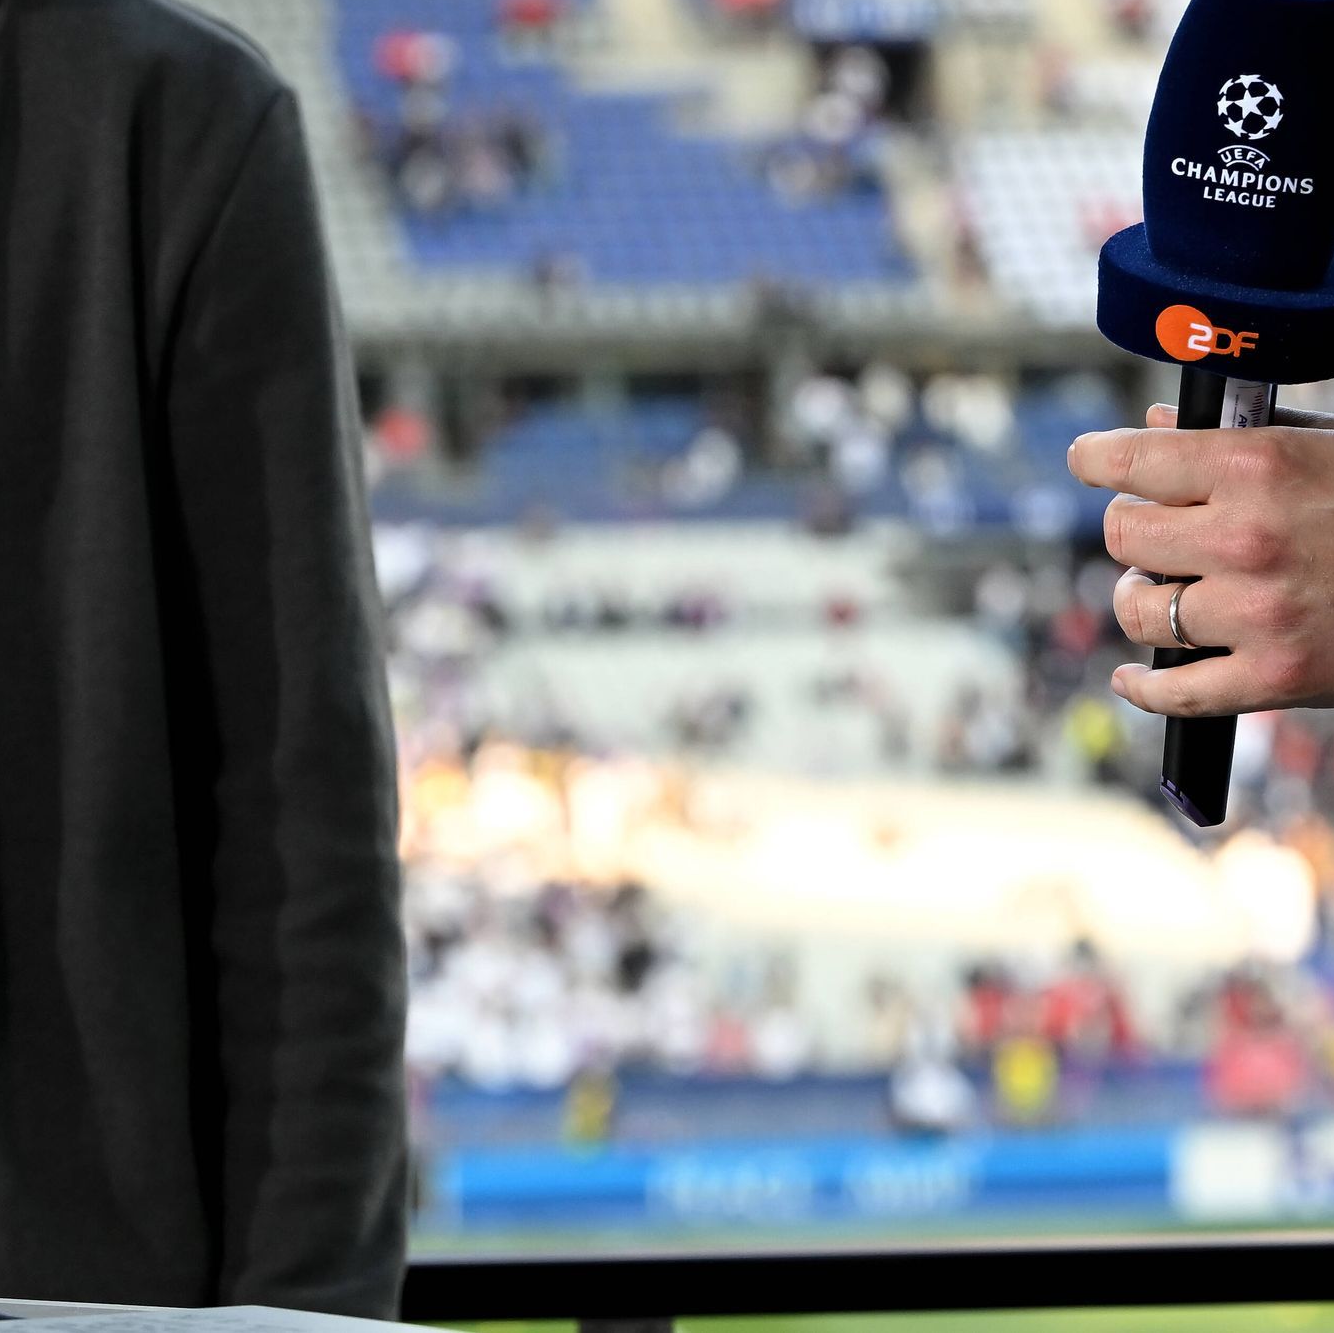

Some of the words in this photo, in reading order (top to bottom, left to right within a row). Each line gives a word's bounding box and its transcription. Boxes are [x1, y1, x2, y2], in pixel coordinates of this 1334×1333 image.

[1220, 148, 1266, 169] UEFA
[1171, 157, 1314, 194] CHAMPIONS
[1203, 186, 1276, 208] LEAGUE
